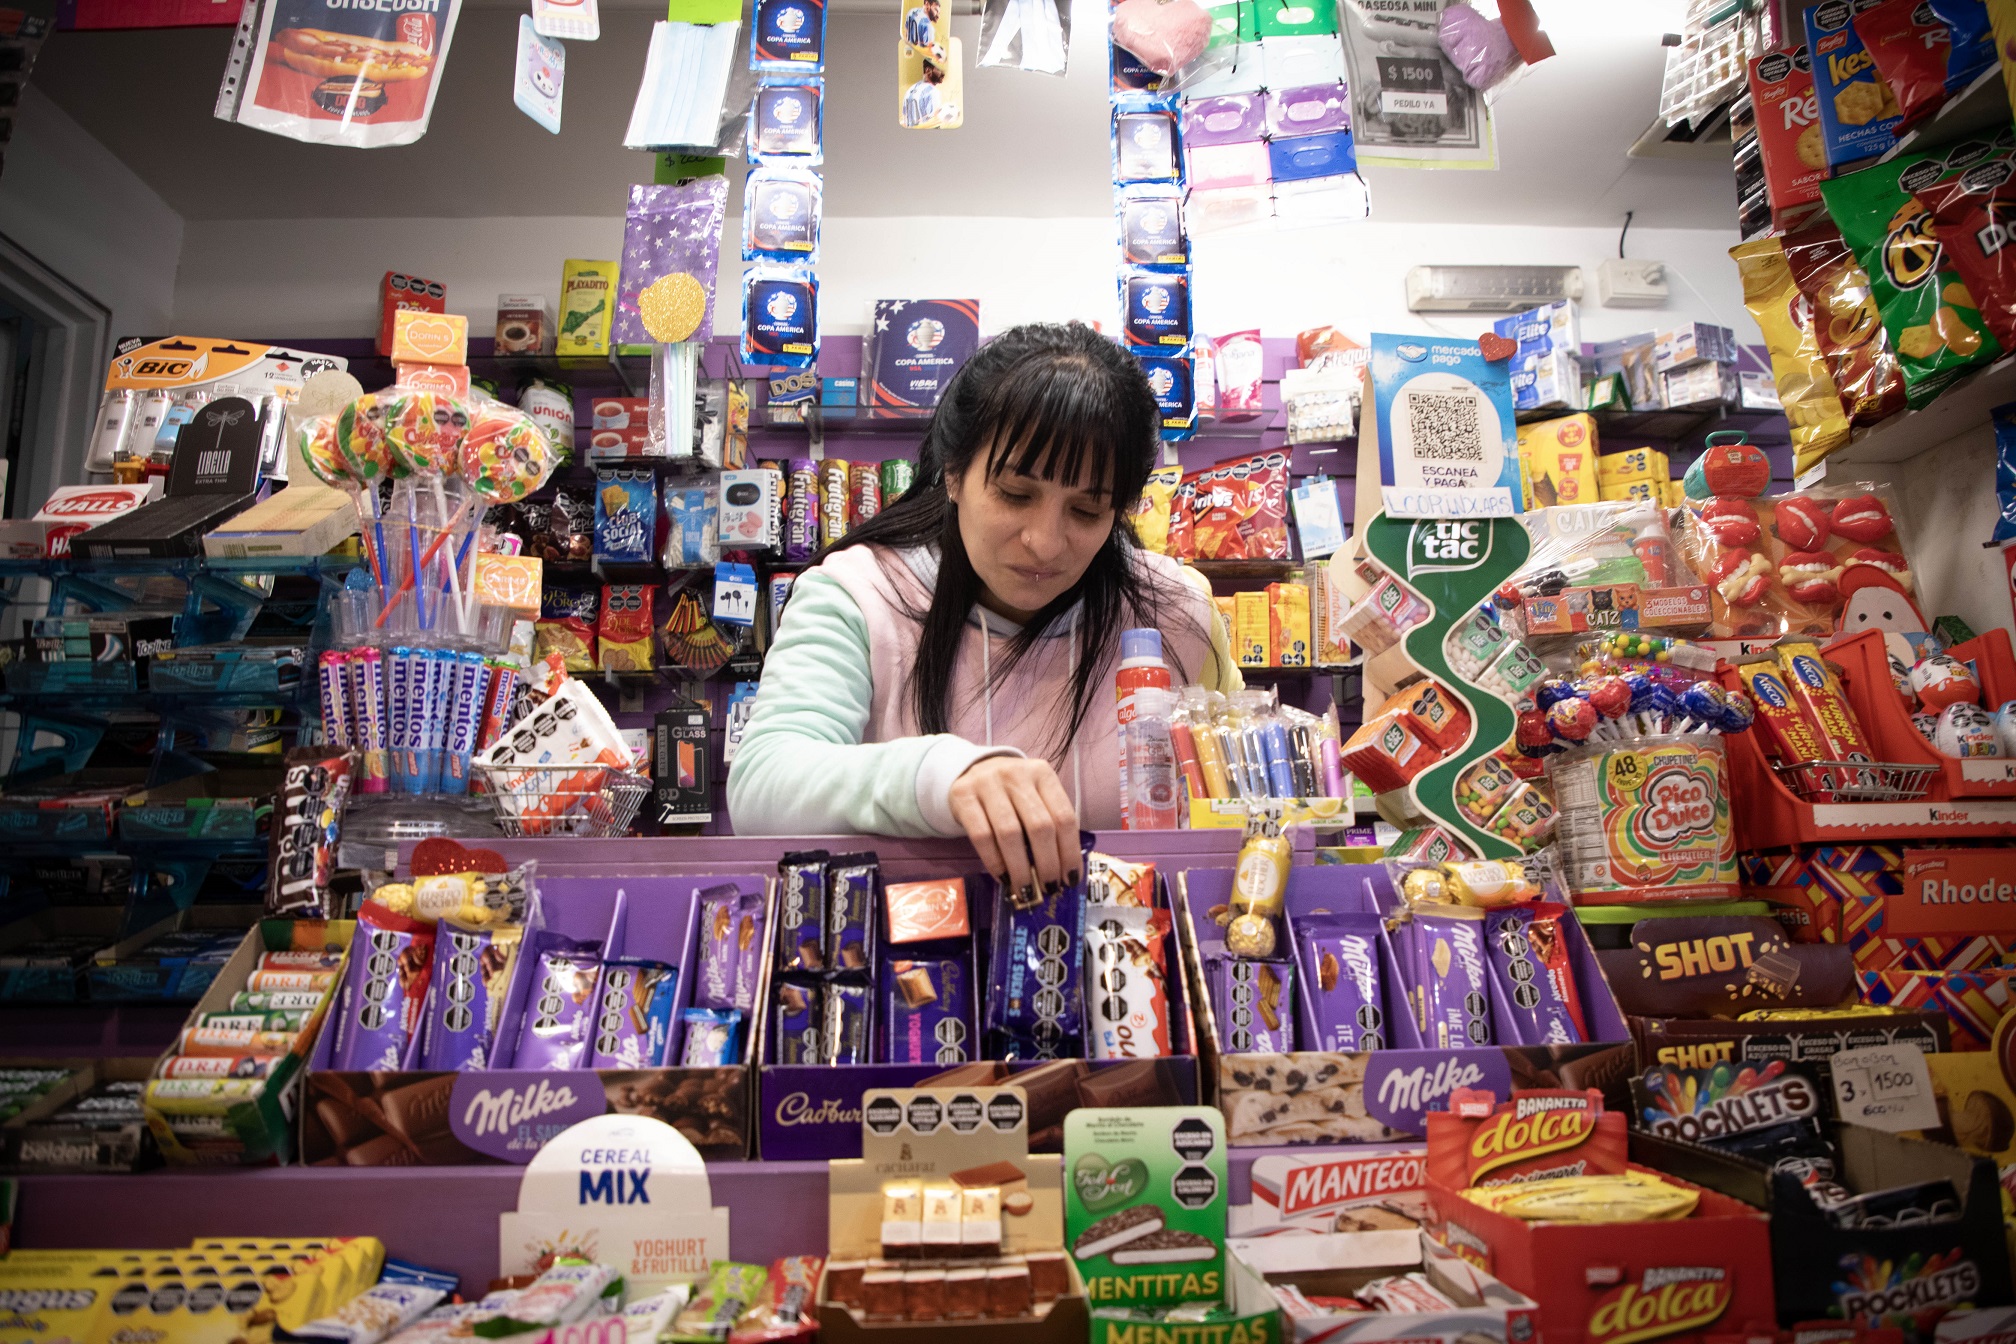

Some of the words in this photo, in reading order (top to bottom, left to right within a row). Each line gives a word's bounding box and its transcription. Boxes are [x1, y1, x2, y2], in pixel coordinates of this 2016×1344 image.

[1413, 0, 1437, 11] MINI
[766, 36, 783, 44] COPA
[1388, 67, 1398, 80] $
[1402, 67, 1434, 80] 1500
[1394, 99, 1421, 109] PEDILO
[1423, 100, 1435, 109] YA
[764, 127, 782, 135] COPA
[1837, 125, 1877, 143] HECHAS
[1791, 173, 1822, 187] SABOR
[778, 224, 806, 232] AMERICA
[566, 280, 609, 293] PLAYADITO
[757, 324, 774, 332] COPA
[775, 325, 805, 334] AMERICA
[1518, 323, 1549, 342] Elite
[118, 337, 142, 352] NUEVA
[121, 342, 143, 354] IMAGEN
[1431, 344, 1482, 357] mercado
[1431, 354, 1462, 365] pago
[769, 373, 816, 396] DOS
[834, 379, 856, 388] casino
[197, 449, 232, 475] LIBELLA
[1422, 465, 1478, 478] ESCANEÁ
[1423, 477, 1431, 487] Y
[51, 498, 134, 513] HALLS
[789, 472, 811, 544] Frutigran
[824, 468, 846, 540] Frutigran
[609, 513, 638, 528] CLUB
[1435, 519, 1480, 540] tic
[1556, 508, 1610, 534] CATZ
[603, 522, 645, 542] SOCIAL
[1423, 535, 1479, 559] tac
[773, 583, 786, 607] MIX
[1652, 596, 1687, 608] MODELOS
[1332, 588, 1340, 637] andwich
[1586, 609, 1621, 626] CATZ
[1643, 604, 1707, 617] COLECCIONABLES
[1799, 660, 1823, 688] ARCOR
[493, 671, 511, 717] mentos
[1758, 676, 1785, 708] ARCOR
[393, 661, 407, 747] mentos
[408, 661, 427, 748] mentos
[453, 665, 477, 751] mentos
[1825, 698, 1859, 746] TURRON
[1957, 734, 1994, 744] Kinder
[1615, 756, 1636, 777] 48
[1654, 753, 1698, 767] CHUPETINES
[1657, 781, 1701, 804] Pico
[1652, 798, 1710, 832] Dulce
[1929, 808, 1969, 821] Kinder
[1013, 927, 1028, 961] TRES
[1451, 922, 1484, 990] Milka
[1654, 931, 1755, 982] SHOT
[708, 955, 726, 999] Milka
[1339, 934, 1377, 1003] Milka
[1746, 1043, 1774, 1052] EXCESO
[1779, 1044, 1791, 1052] EN
[1829, 1037, 1840, 1045] EN
[1848, 1036, 1874, 1045] EXCESO
[1875, 1036, 1886, 1044] EN
[1657, 1041, 1735, 1070] SHOT
[1378, 1057, 1485, 1113] Milka
[1840, 1081, 1855, 1102] 3
[1874, 1072, 1913, 1091] 1500
[464, 1080, 578, 1136] Milka
[1516, 1097, 1587, 1119] BANANITA
[1656, 1080, 1814, 1139] ROCKLETS
[518, 1125, 532, 1140] EL
[1472, 1111, 1582, 1159] dolca
[20, 1142, 99, 1162] beldent
[580, 1149, 652, 1164] CEREAL
[579, 1168, 651, 1206] MIX
[634, 1238, 707, 1258] YOGHURT
[1846, 1263, 1976, 1318] ROCKLETS
[1589, 1284, 1715, 1336] dolca
